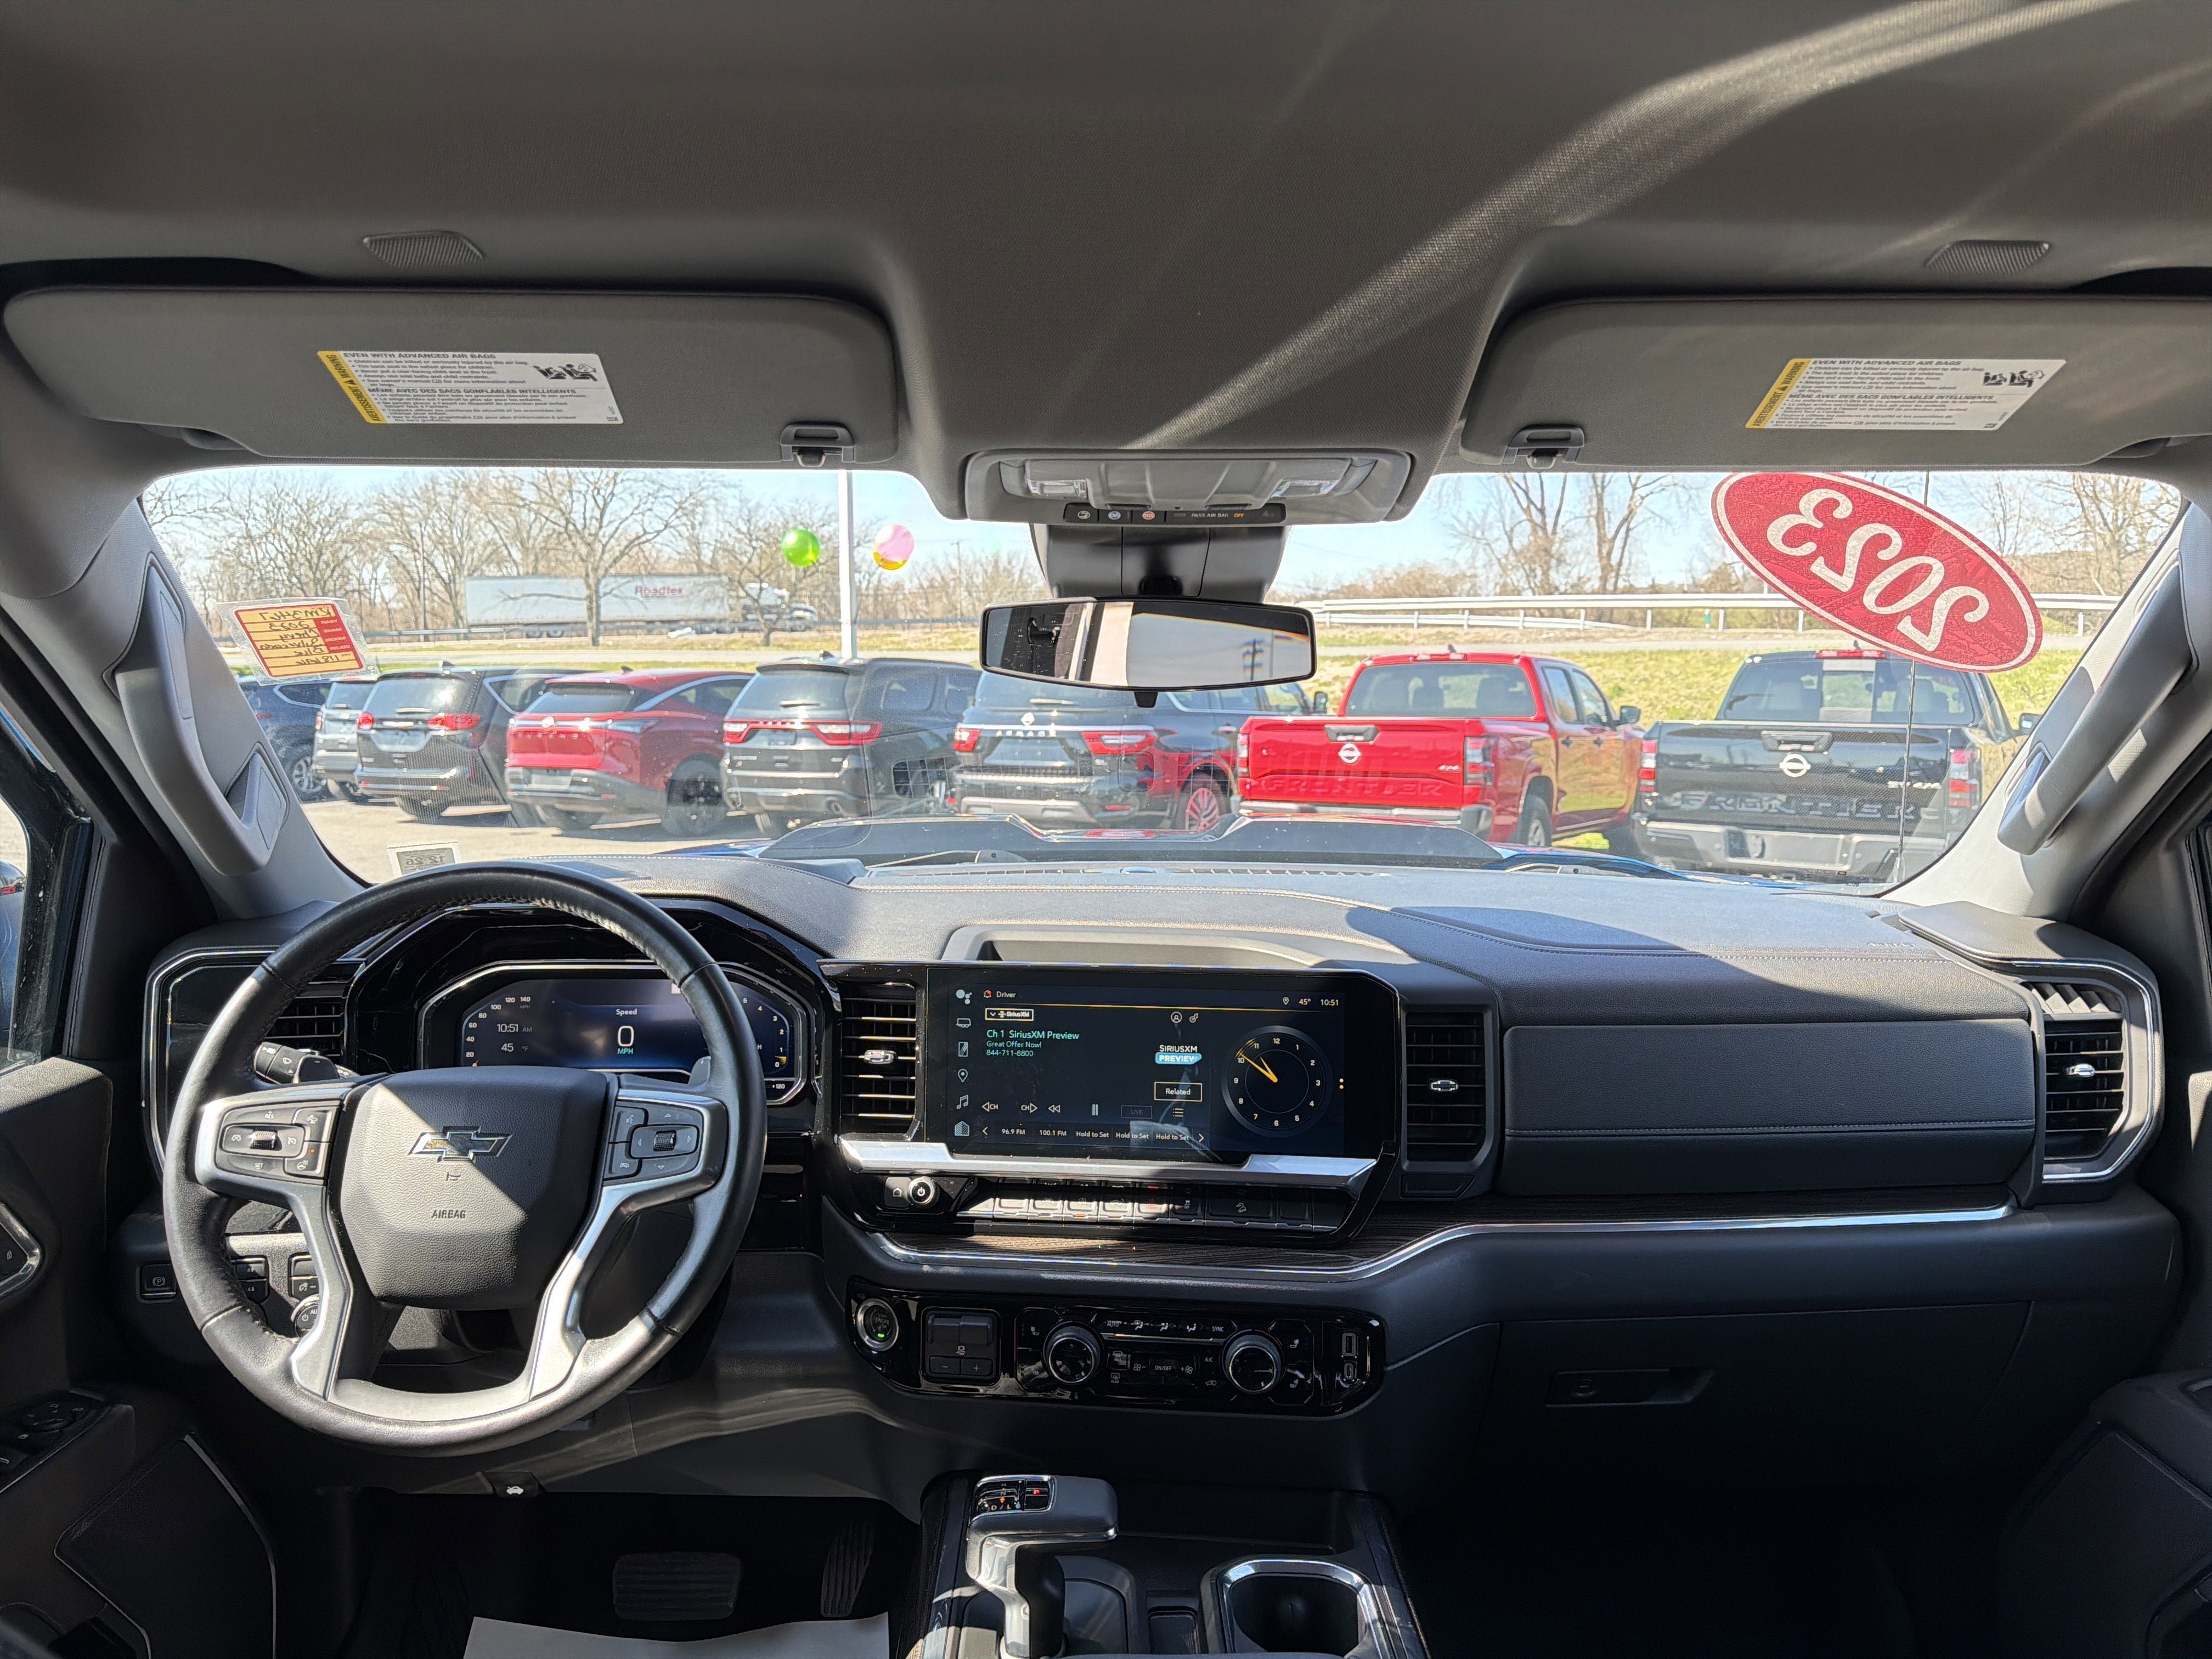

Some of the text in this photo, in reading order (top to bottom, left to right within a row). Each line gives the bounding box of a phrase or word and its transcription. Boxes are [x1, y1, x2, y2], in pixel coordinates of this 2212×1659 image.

[616, 1008, 637, 1017] Speed
[496, 1023, 518, 1032] 10:51
[617, 1025, 635, 1047] 0
[986, 1029, 1080, 1040] Ch 1 SiriusXM Preview
[501, 1043, 514, 1052] 45
[1159, 1045, 1198, 1053] SIRIUSXM
[1159, 1054, 1198, 1063] PREVIEW
[431, 1209, 466, 1219] AIRBAG
